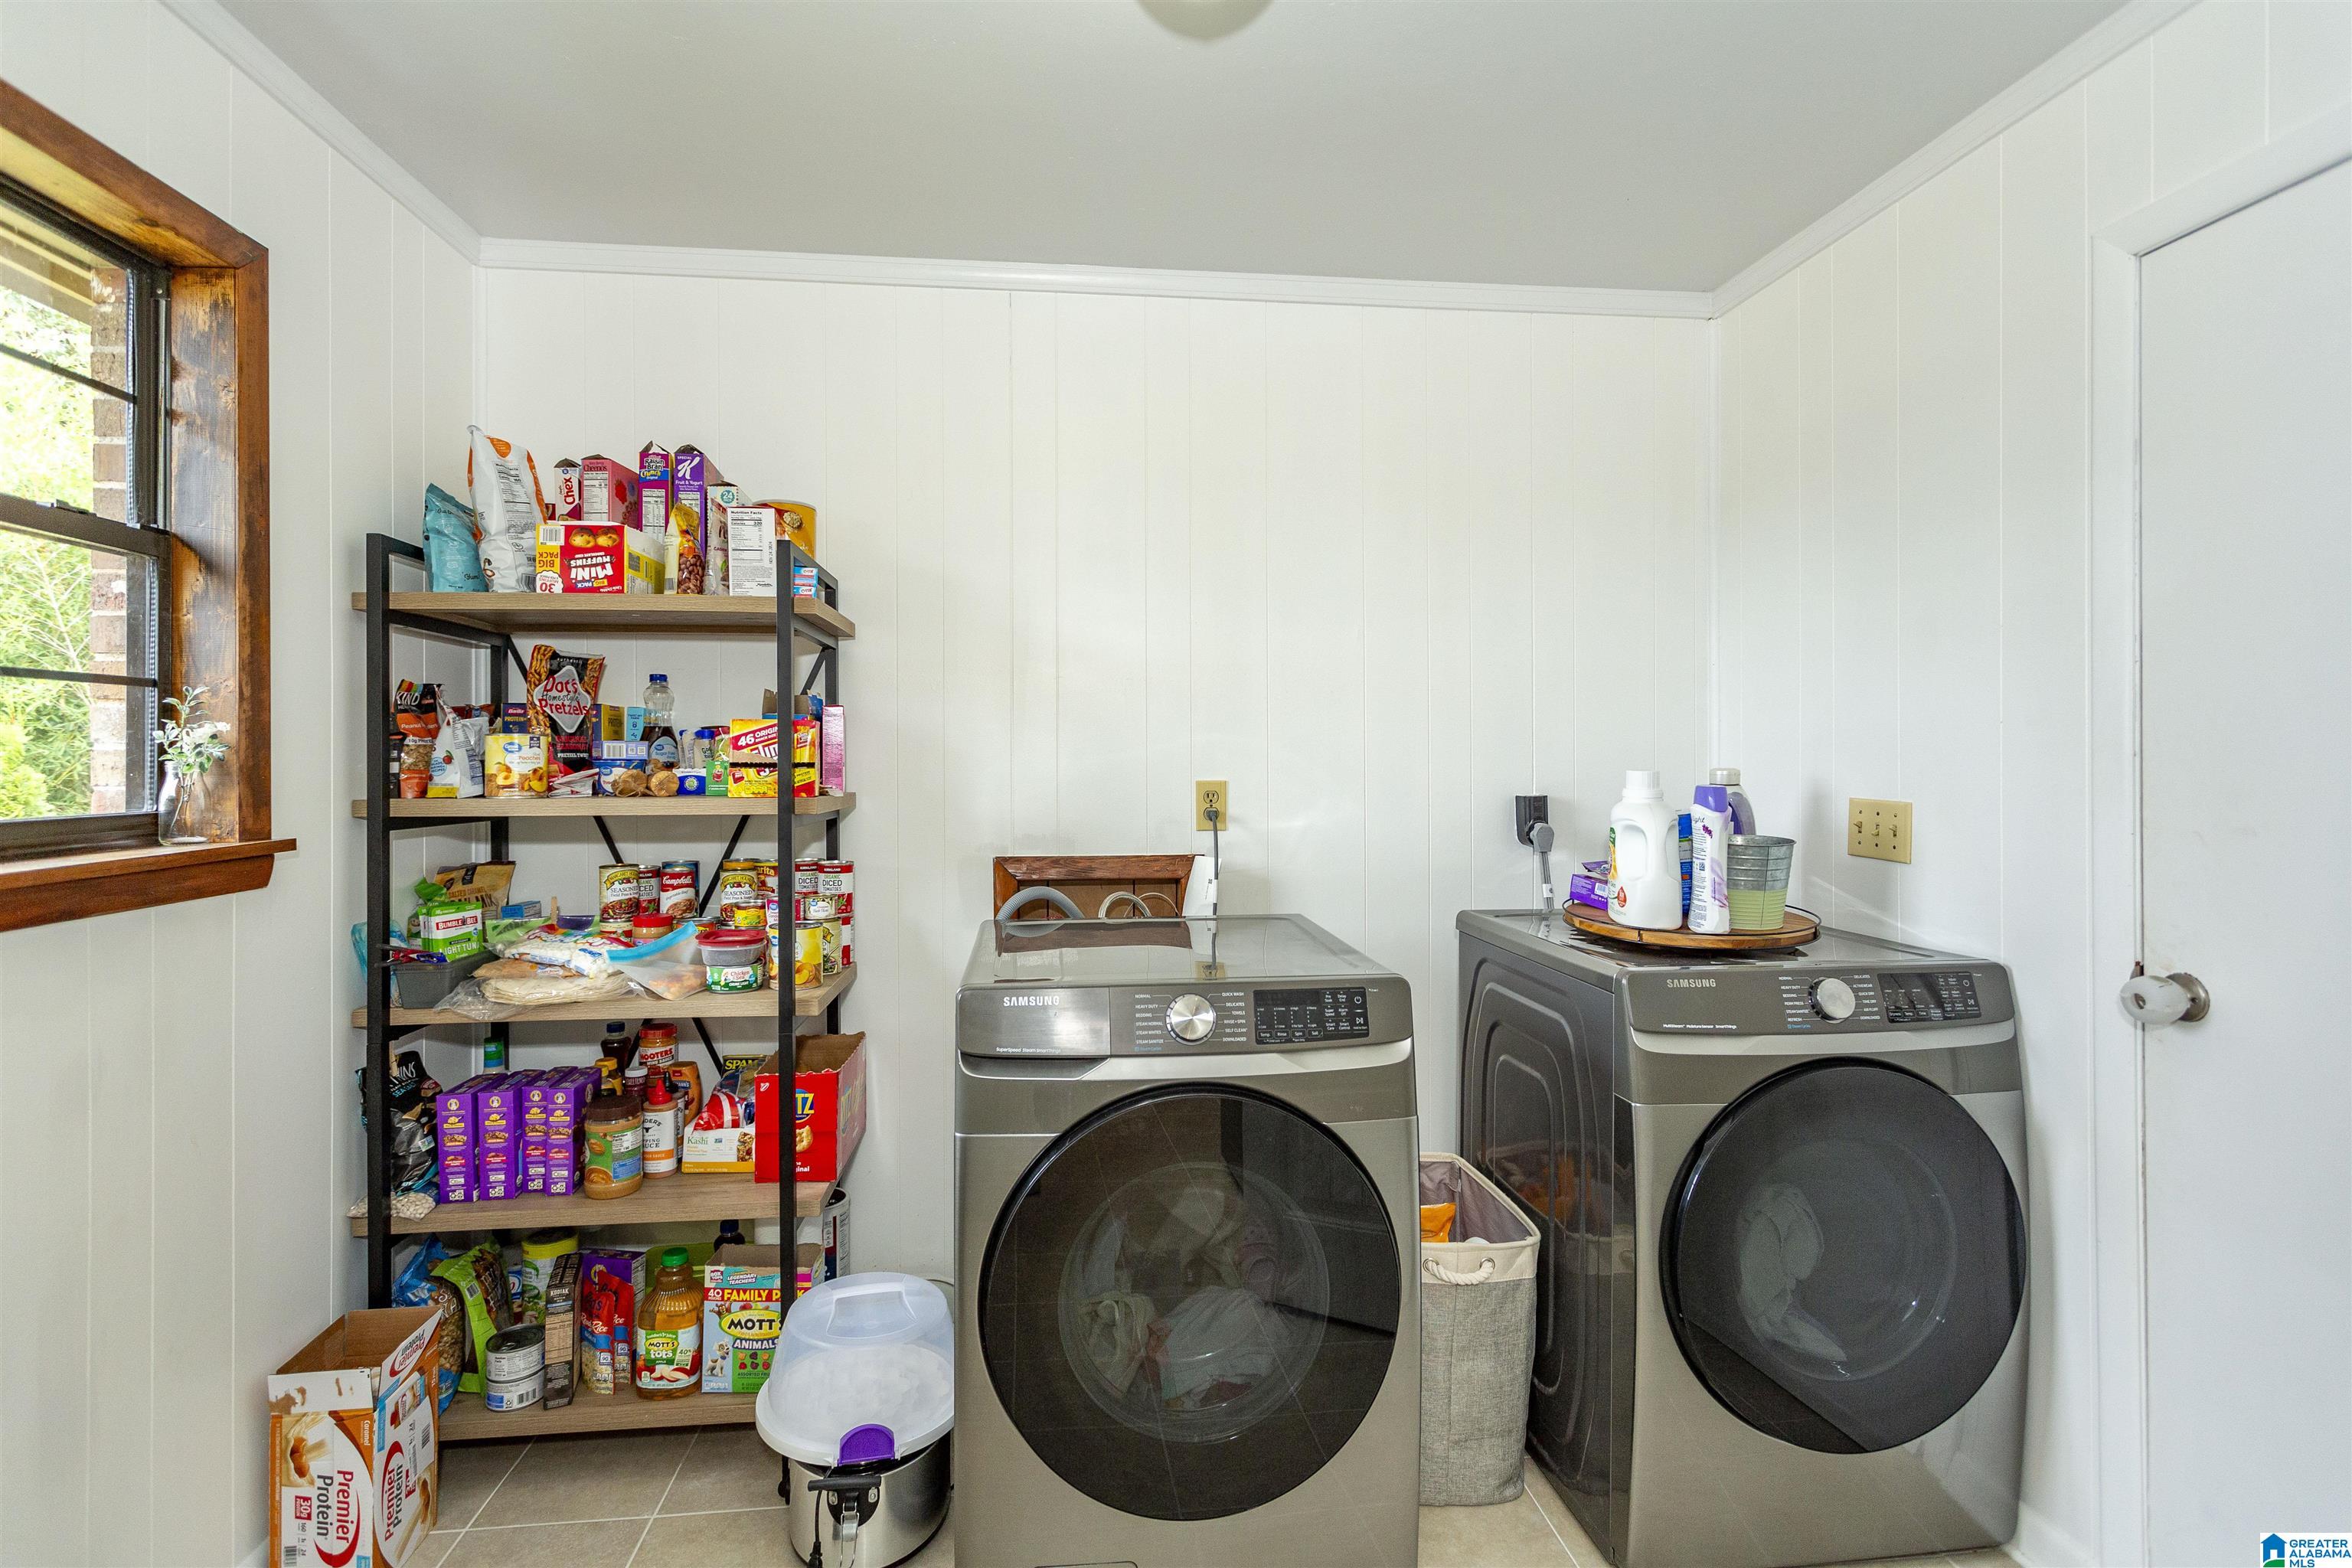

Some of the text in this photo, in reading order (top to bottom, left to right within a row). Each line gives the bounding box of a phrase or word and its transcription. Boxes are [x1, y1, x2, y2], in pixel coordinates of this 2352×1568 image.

[678, 457, 700, 479] K
[564, 477, 576, 505] Chex
[570, 556, 610, 567] MUFFINS
[540, 583, 556, 593] 30
[544, 675, 578, 694] Dot's
[397, 692, 420, 706] KIND
[538, 698, 589, 716] Pretzels
[737, 733, 755, 746] 46
[439, 920, 463, 929] BUMBLE
[1667, 978, 1717, 988] SAMSUNG
[1003, 996, 1060, 1007] SAMSUNG
[641, 1048, 673, 1060] HOOTERS
[795, 1093, 815, 1114] TZ
[644, 1119, 662, 1127] DERS
[688, 1136, 708, 1145] Kashi
[724, 1290, 805, 1301] FAMILY PK
[592, 1321, 609, 1334] Rice
[398, 1336, 426, 1370] Premier
[650, 1350, 673, 1359] tots
[394, 1464, 403, 1528] Protein
[300, 1498, 311, 1517] 30g
[317, 1475, 334, 1537] Protein
[336, 1470, 354, 1544] Premier
[385, 1467, 395, 1542] Premier
